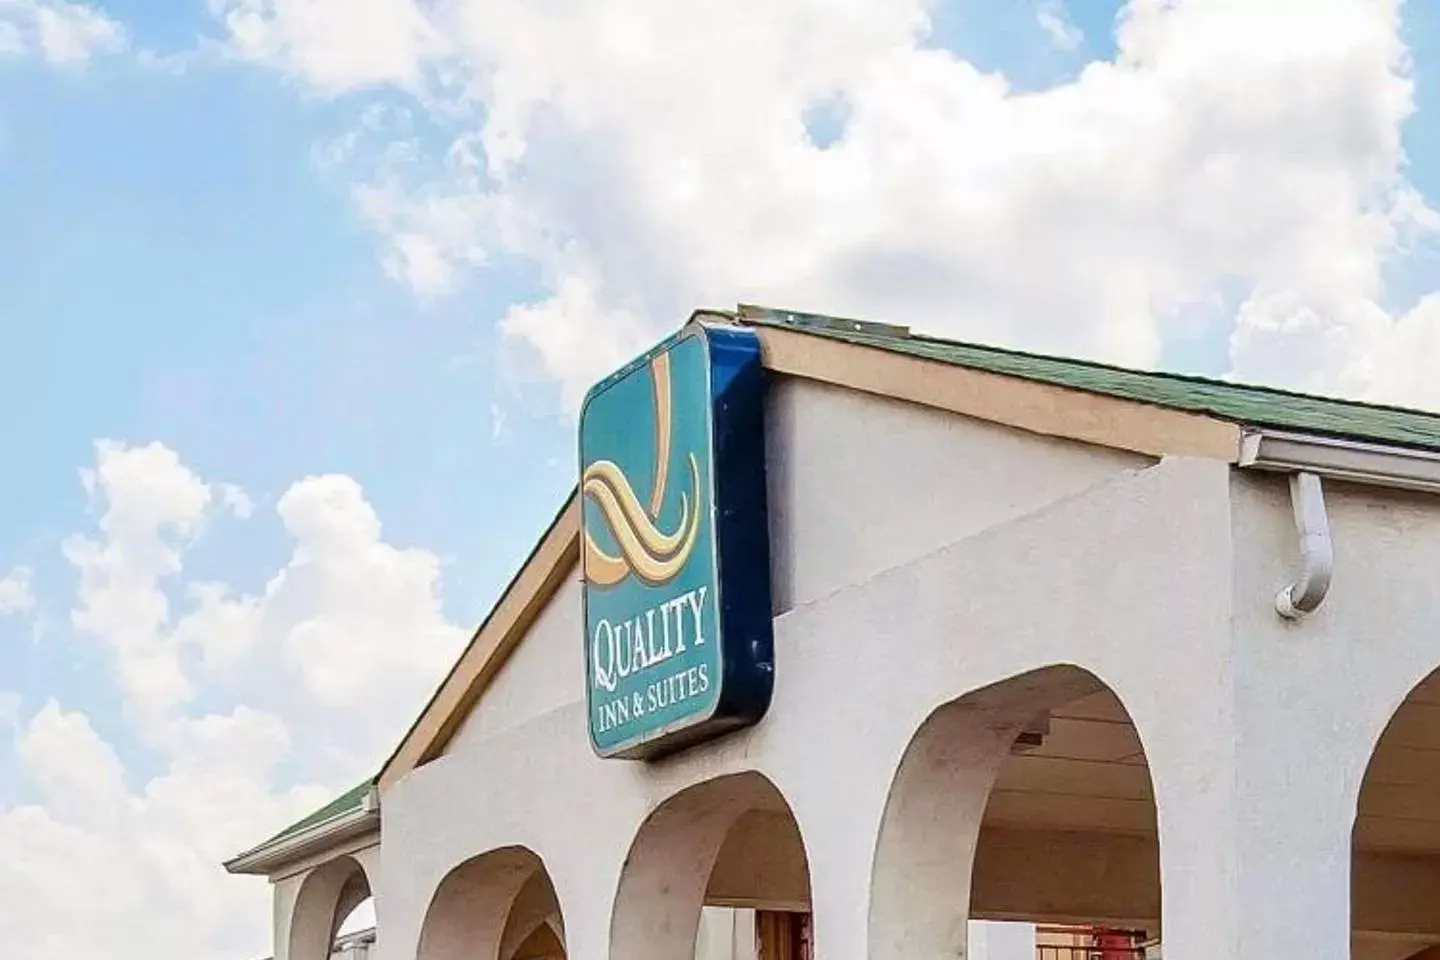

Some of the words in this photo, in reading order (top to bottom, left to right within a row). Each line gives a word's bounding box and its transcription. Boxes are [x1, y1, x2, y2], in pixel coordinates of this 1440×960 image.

[594, 586, 707, 691] QUALITY
[598, 697, 632, 732] INN
[632, 692, 645, 717] &
[648, 663, 709, 712] SUITES
